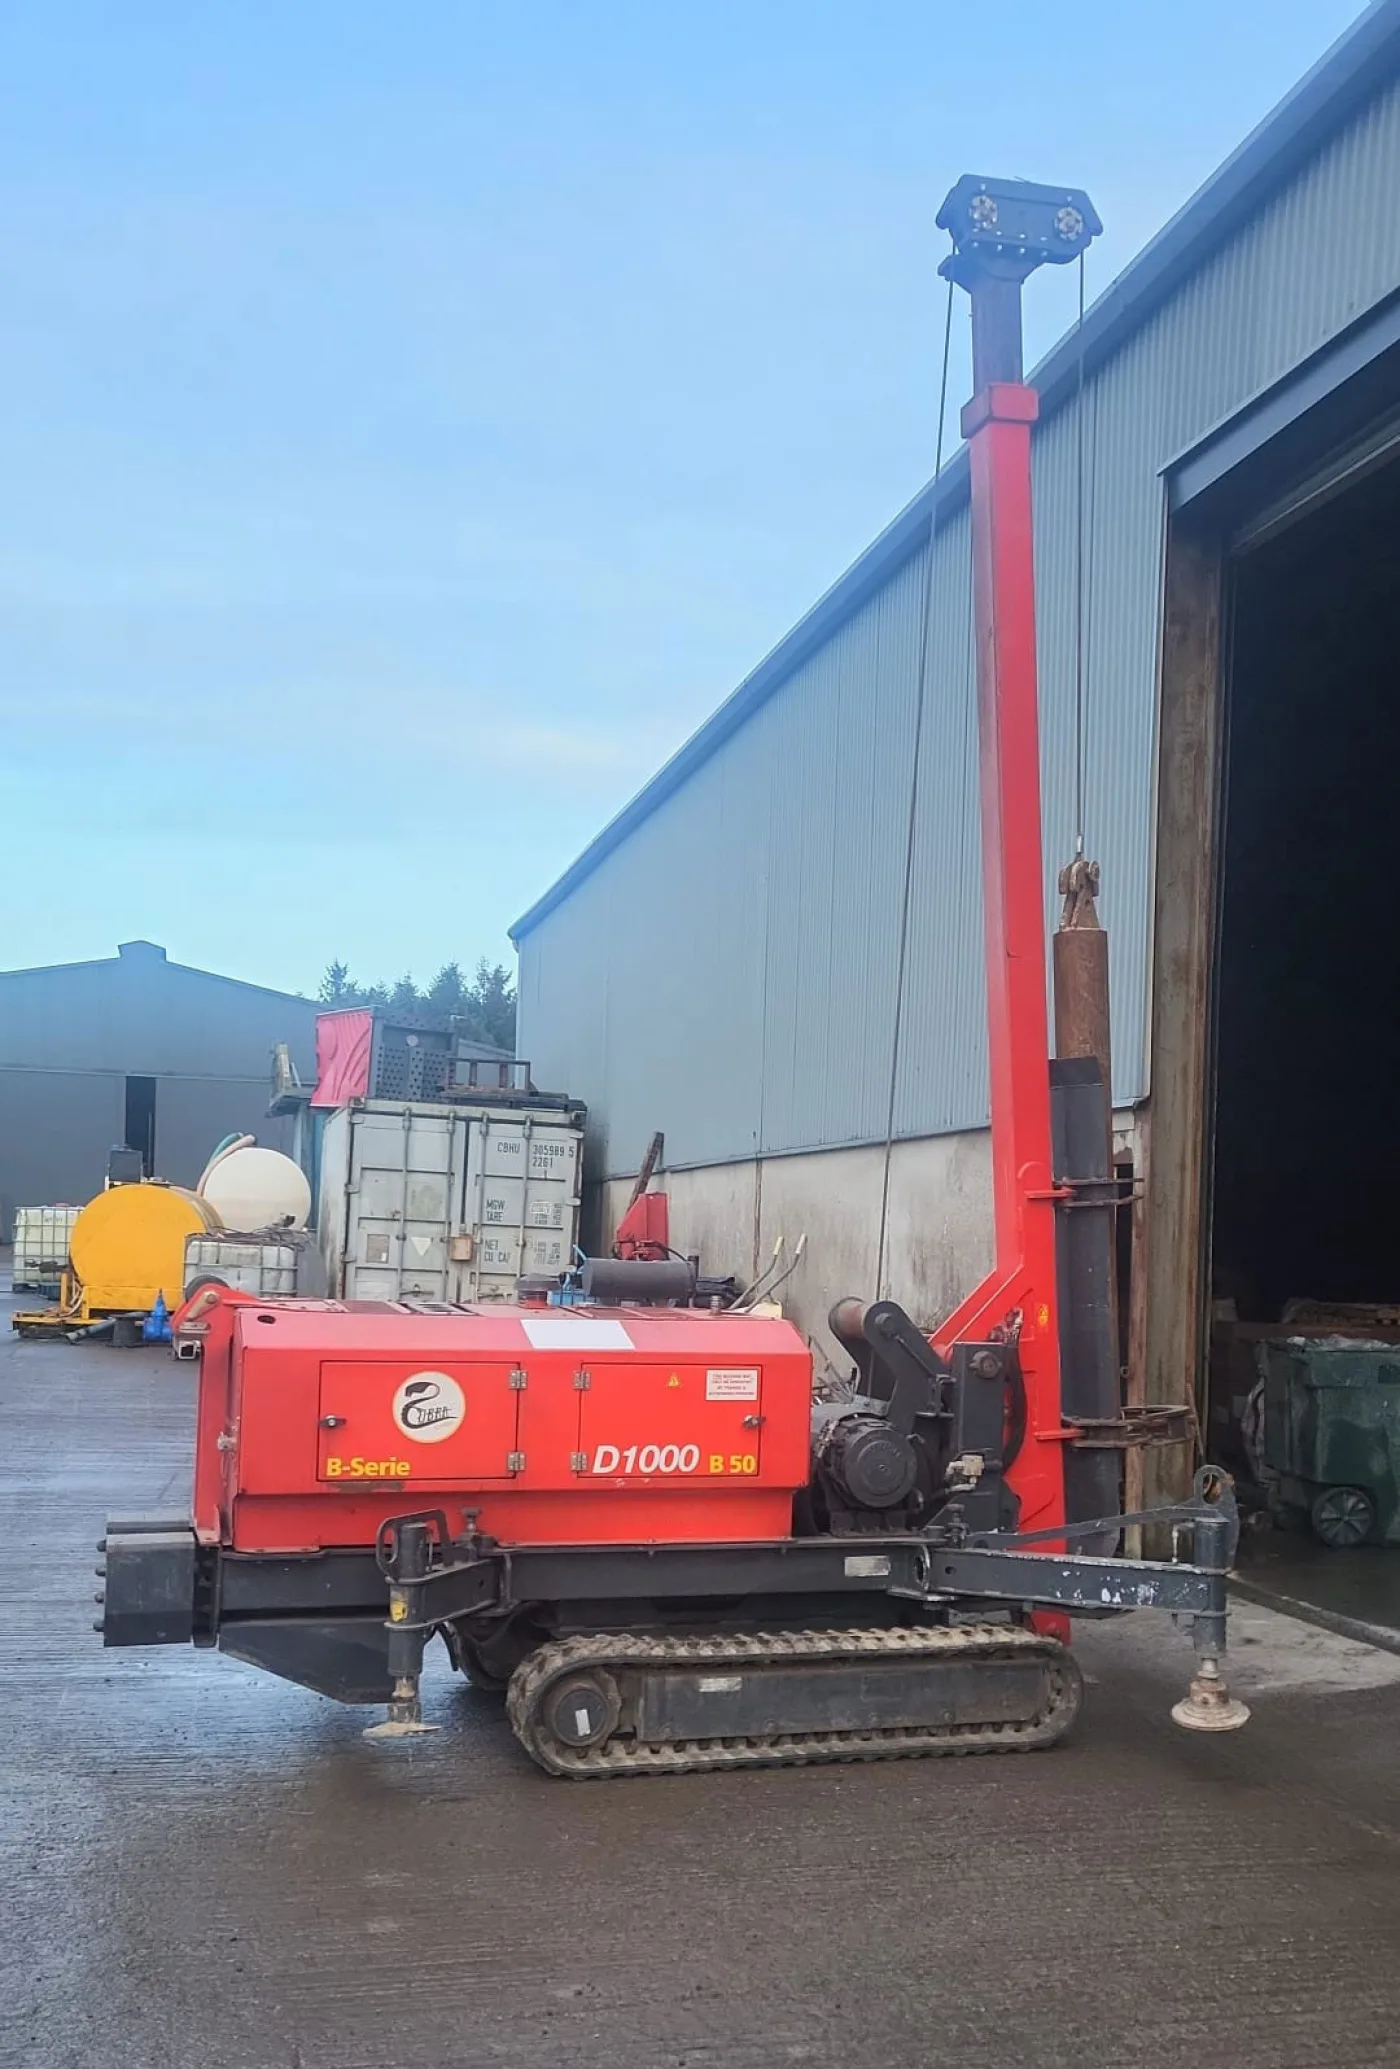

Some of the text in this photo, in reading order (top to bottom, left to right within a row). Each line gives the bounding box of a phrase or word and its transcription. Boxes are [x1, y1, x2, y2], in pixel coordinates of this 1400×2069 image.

[497, 1141, 575, 1158] CBHU 305989 5
[326, 1456, 411, 1477] B-Serie
[592, 1444, 757, 1474] D1000 B 50
